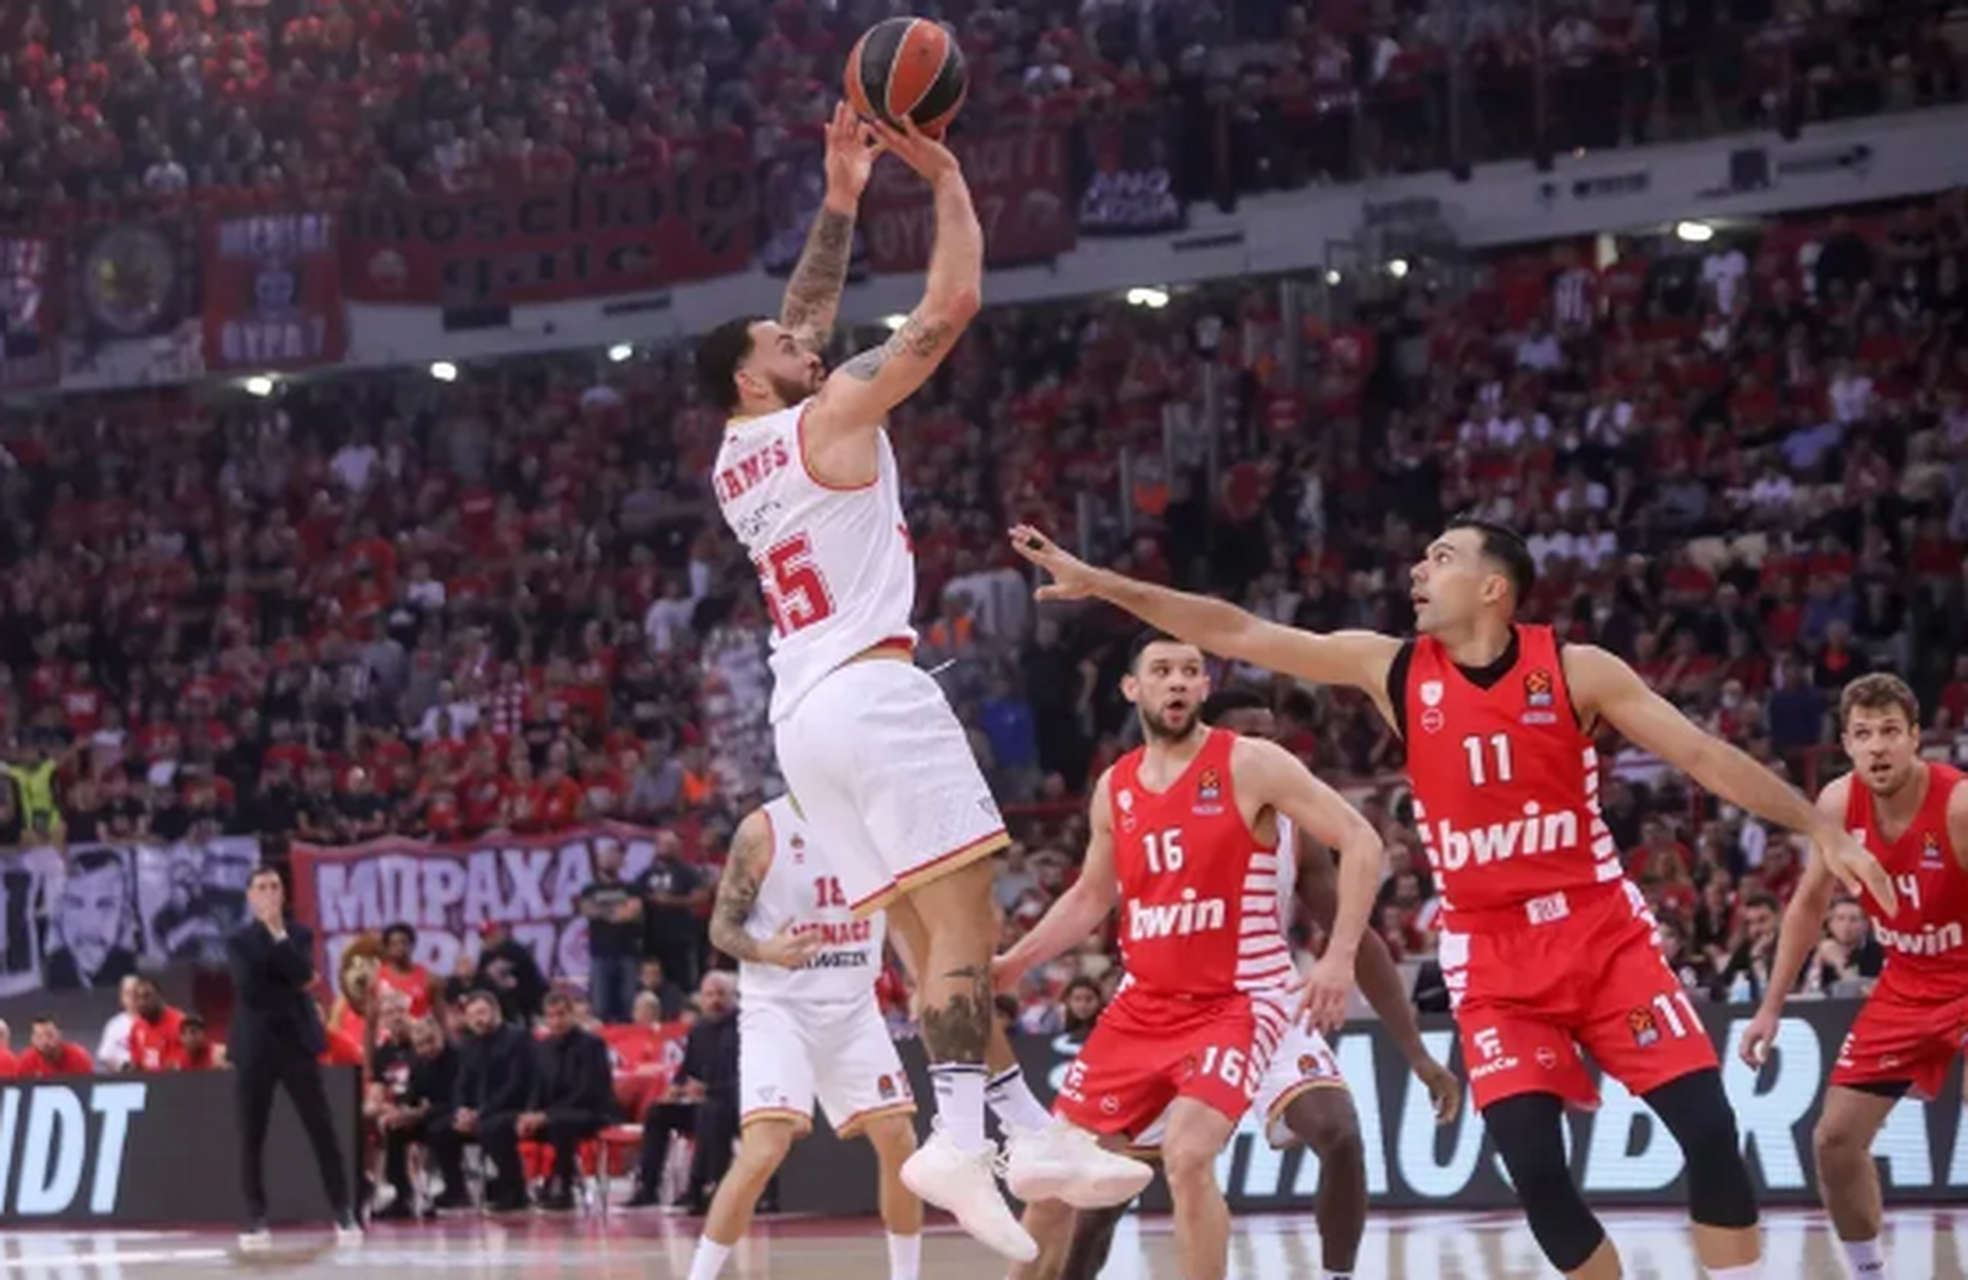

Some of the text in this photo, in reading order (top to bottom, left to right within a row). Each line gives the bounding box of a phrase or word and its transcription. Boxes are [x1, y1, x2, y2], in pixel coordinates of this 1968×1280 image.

[1462, 732, 1513, 786] 11
[1142, 829, 1185, 874] 16
[1440, 801, 1578, 870] bwin
[1127, 888, 1226, 941] bwin
[1871, 915, 1964, 957] bwin
[1653, 990, 1704, 1038] 11
[1201, 1046, 1247, 1088] 16
[0, 1083, 146, 1215] DT
